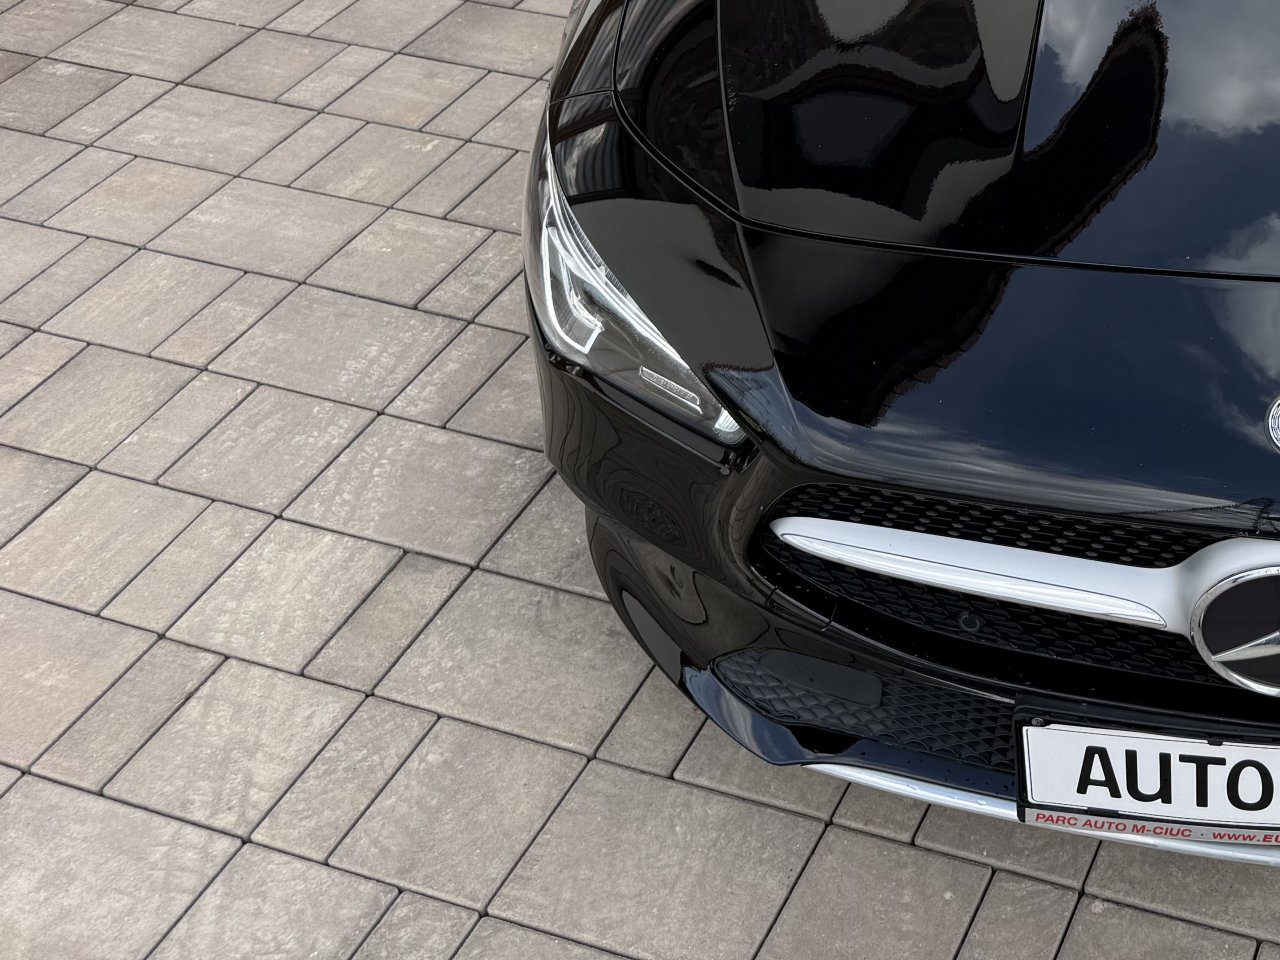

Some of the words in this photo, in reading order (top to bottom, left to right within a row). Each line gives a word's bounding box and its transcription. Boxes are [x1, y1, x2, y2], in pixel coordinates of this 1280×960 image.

[1035, 812, 1079, 826] PARC
[1081, 818, 1127, 832] AUTO
[1131, 824, 1193, 838] M-CIUC
